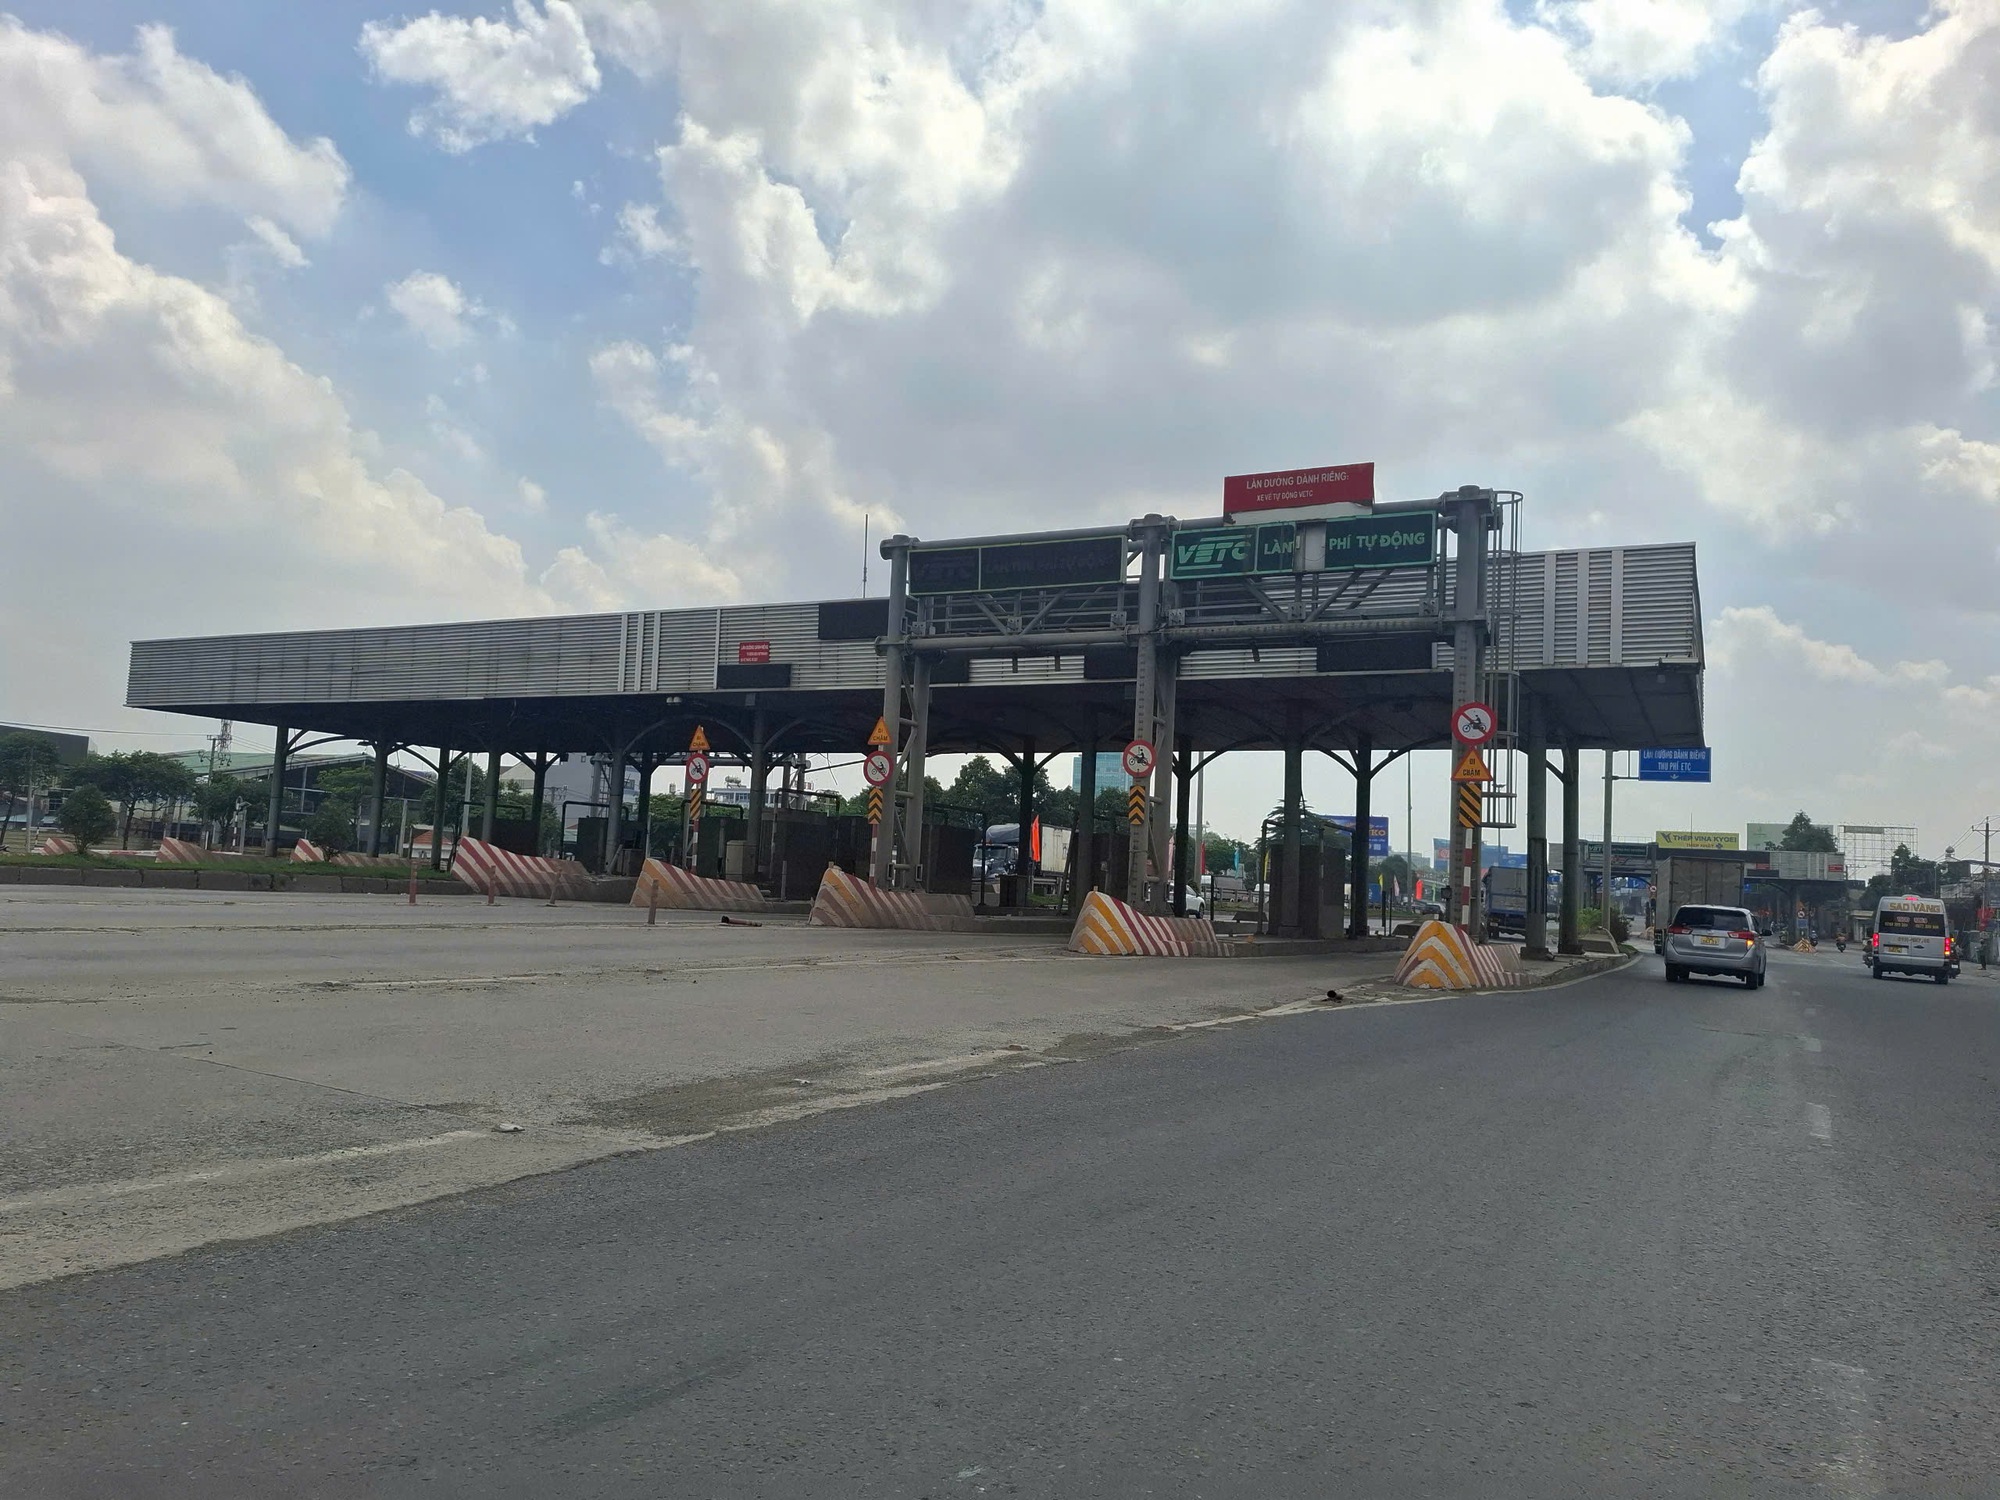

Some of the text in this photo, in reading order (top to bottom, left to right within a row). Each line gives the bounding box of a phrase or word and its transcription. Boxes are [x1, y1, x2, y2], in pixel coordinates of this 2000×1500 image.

[1246, 478, 1262, 489] LÀN
[1299, 490, 1314, 498] VETC
[1329, 534, 1352, 550] PHÍ
[1356, 534, 1378, 551] TỰ
[1380, 530, 1425, 550] ĐỘNG
[1177, 541, 1252, 564] VETC
[1658, 760, 1692, 771] THU PHÍ ETC
